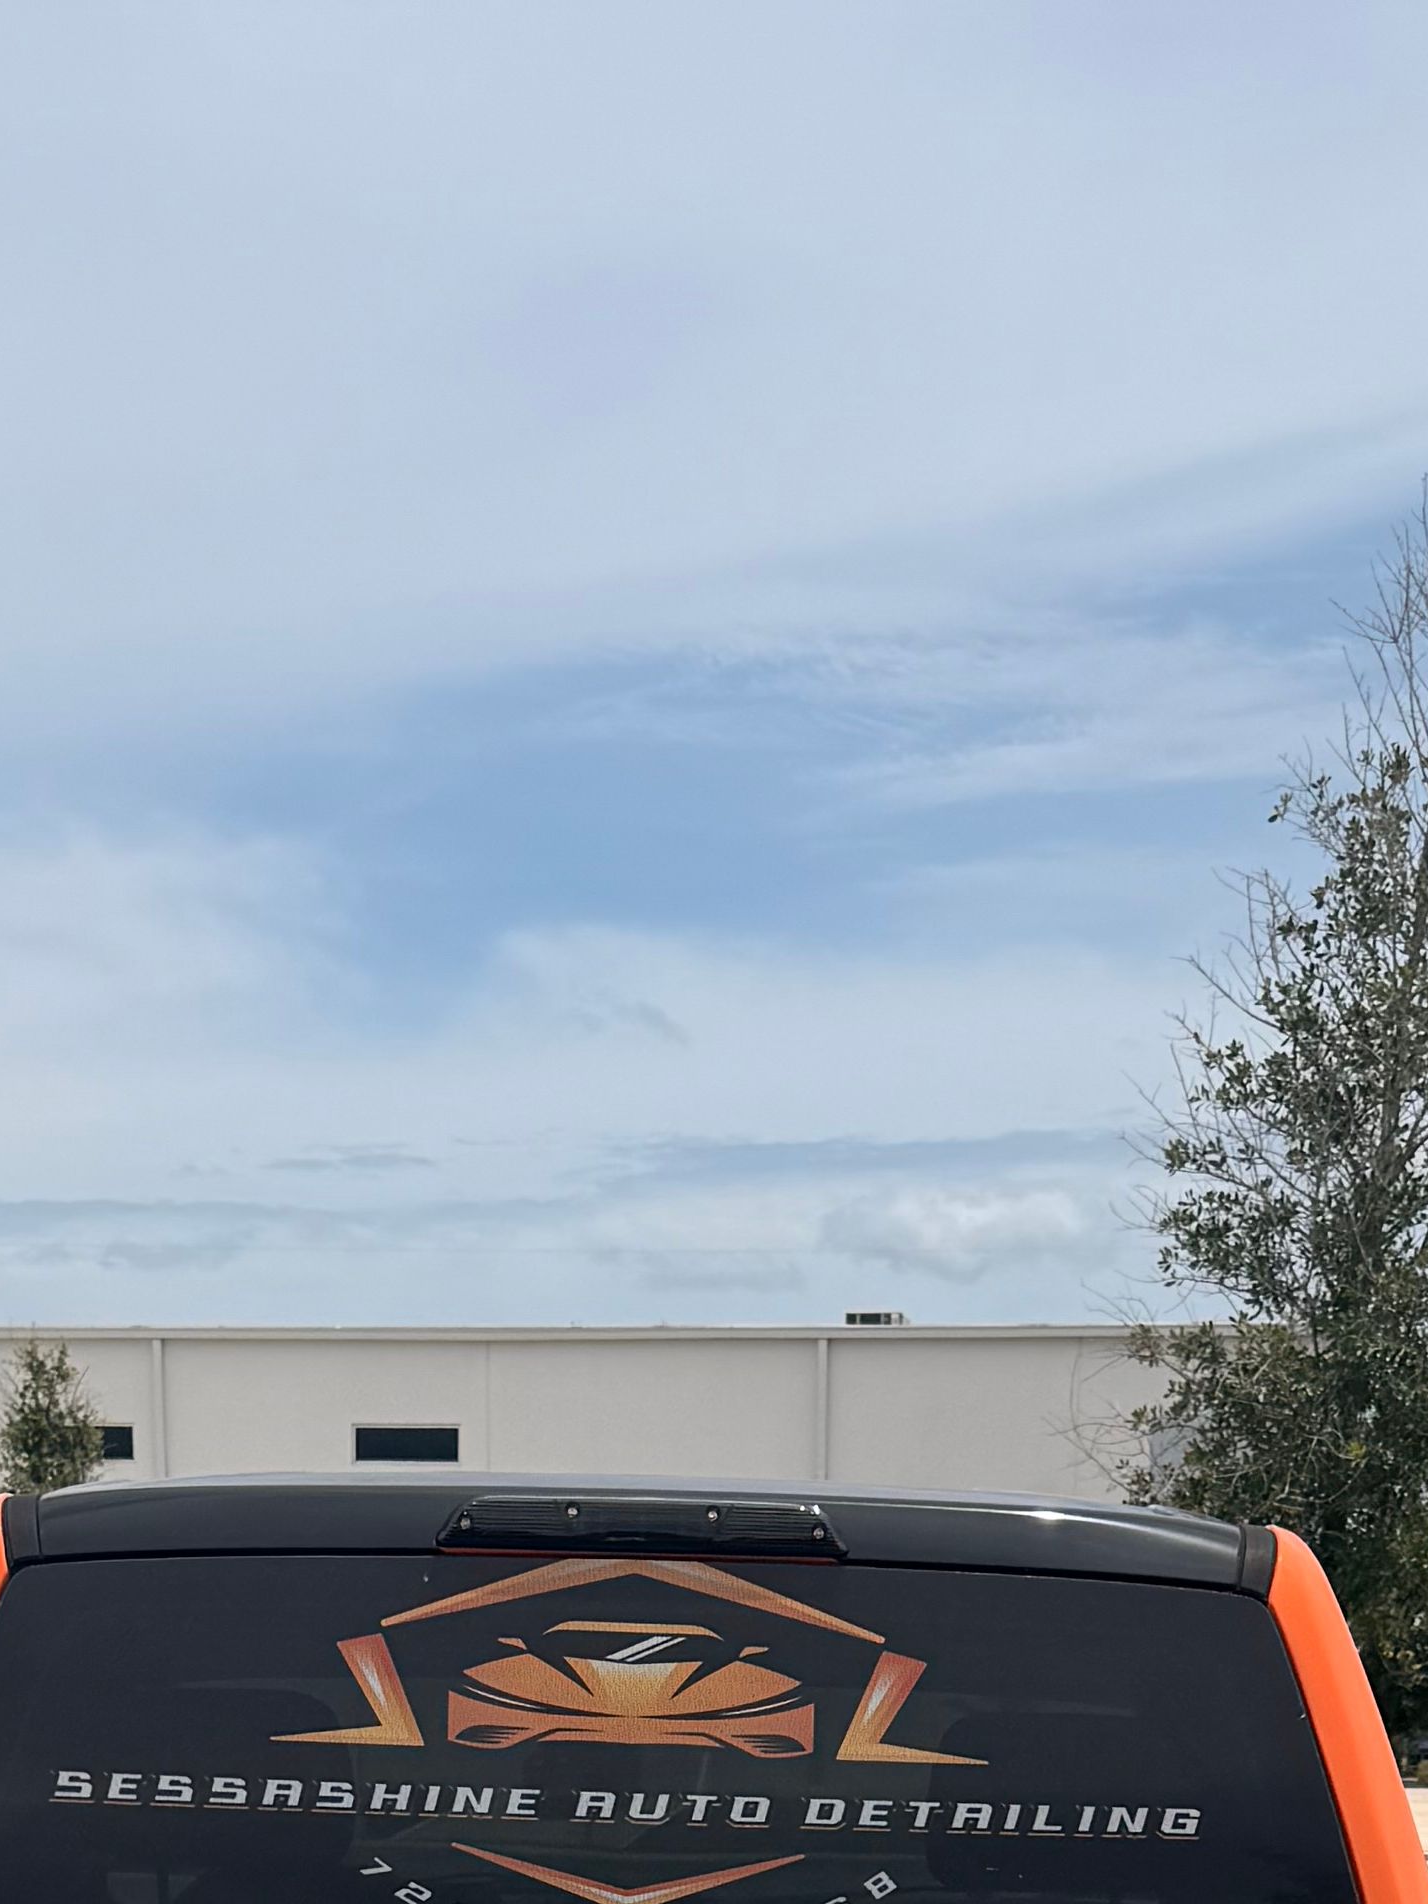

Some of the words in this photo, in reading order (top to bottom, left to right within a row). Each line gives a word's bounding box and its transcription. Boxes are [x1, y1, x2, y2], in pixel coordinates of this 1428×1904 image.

[50, 1770, 541, 1818] SESSASHINE
[572, 1790, 772, 1825] AUTO
[801, 1797, 1203, 1838] DETAILING
